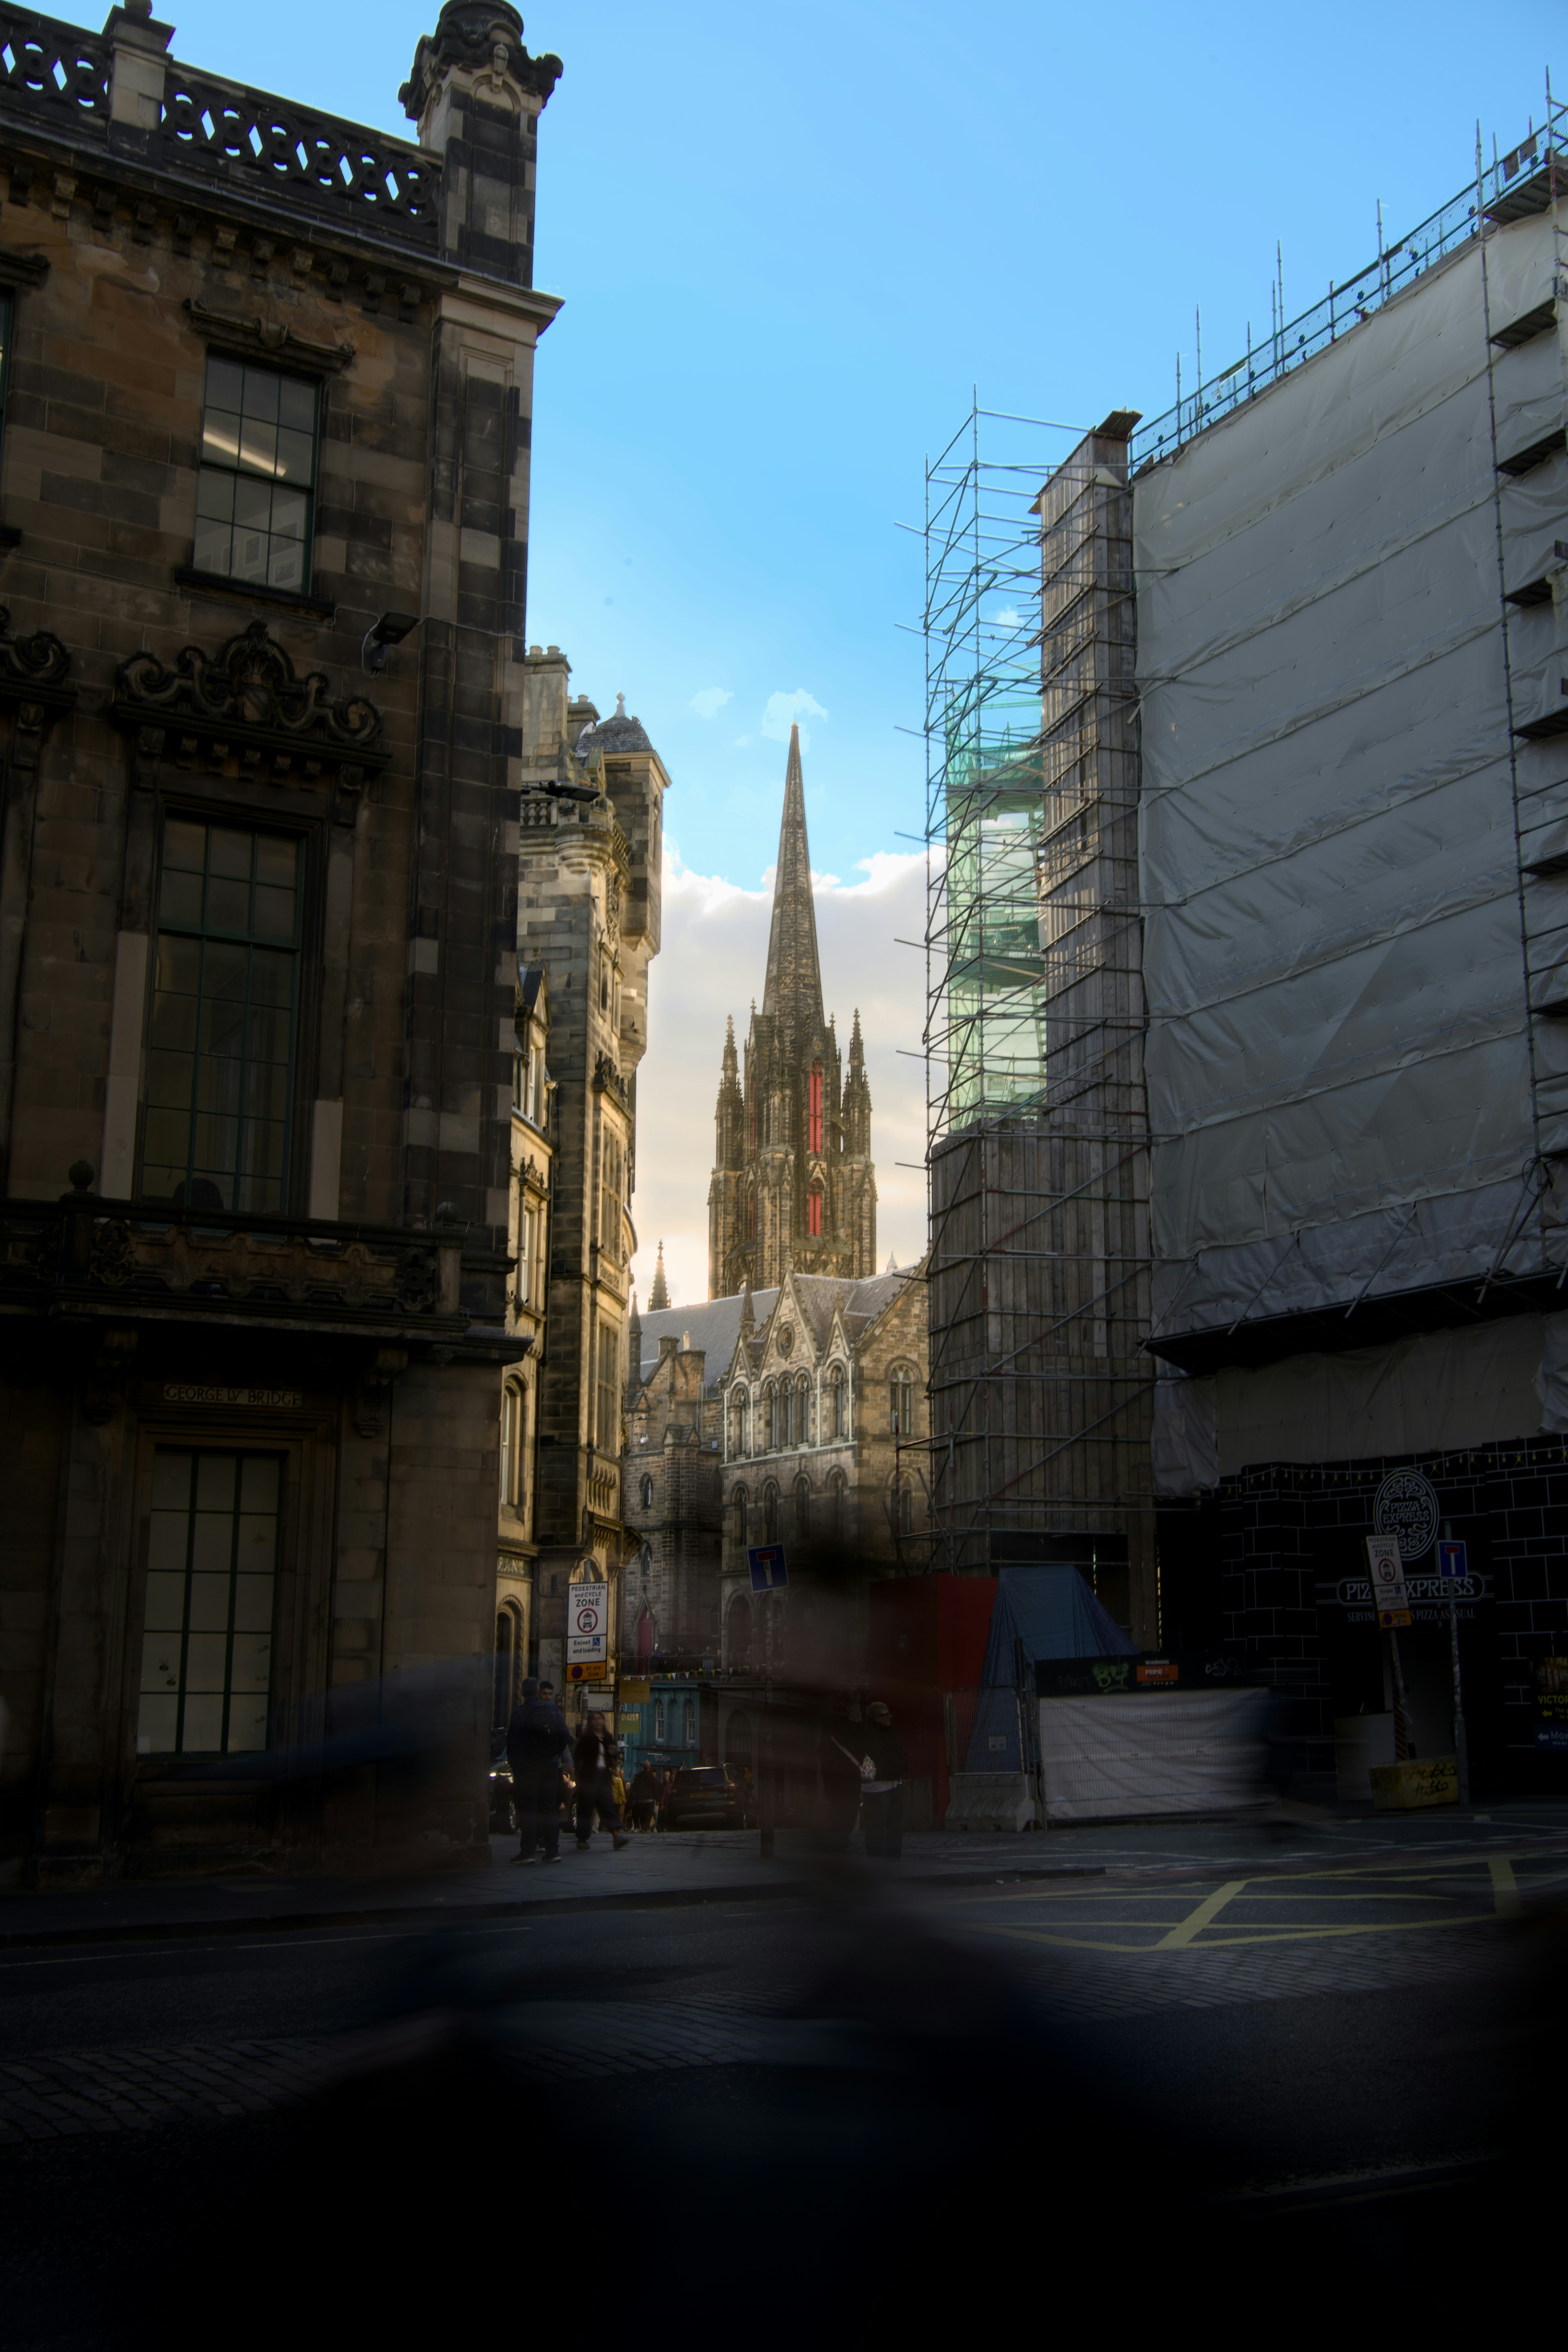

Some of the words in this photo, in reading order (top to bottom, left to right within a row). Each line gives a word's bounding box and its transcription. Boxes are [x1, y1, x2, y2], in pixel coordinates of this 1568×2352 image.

[167, 1386, 223, 1401] GEORGE
[227, 1388, 242, 1402] IV
[248, 1390, 301, 1406] BRIDGE
[1390, 1501, 1420, 1512] PIZZA
[1383, 1510, 1430, 1524] EXPRESS
[1374, 1549, 1395, 1557] ZONE
[1346, 1583, 1371, 1601] PIZ
[1406, 1578, 1475, 1598] XPRESS
[576, 1598, 600, 1607] ZONE
[1416, 1609, 1438, 1621] PIZZA
[1440, 1608, 1450, 1619] AS
[1455, 1608, 1476, 1619] SUAL
